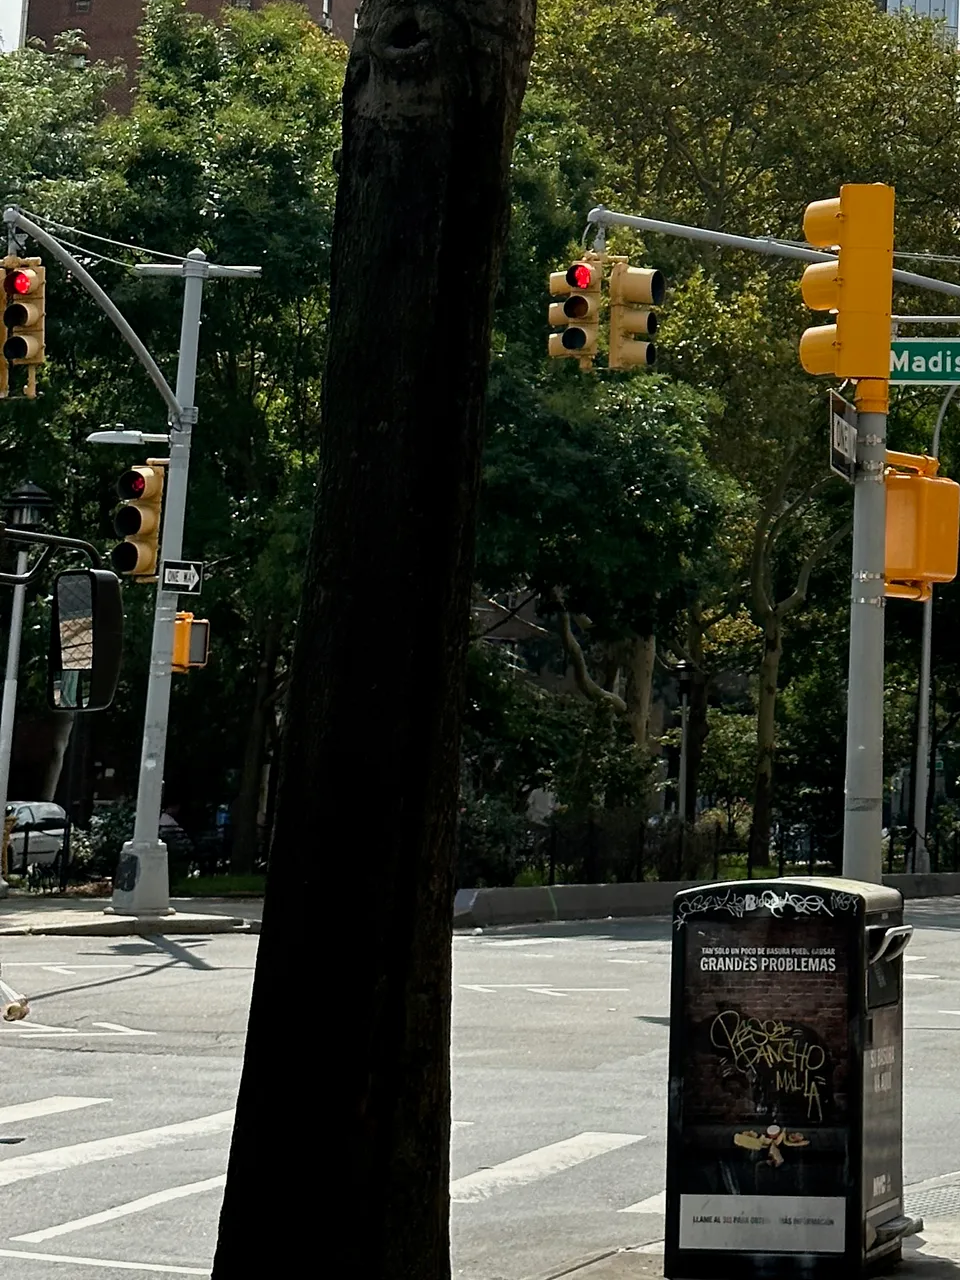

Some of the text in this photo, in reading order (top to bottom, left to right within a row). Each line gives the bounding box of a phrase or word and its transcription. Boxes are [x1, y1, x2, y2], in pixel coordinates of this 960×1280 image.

[167, 570, 179, 582] ONE
[741, 947, 757, 955] POCO
[758, 947, 766, 955] DE
[700, 957, 837, 972] GRANDES PROBLEMAS
